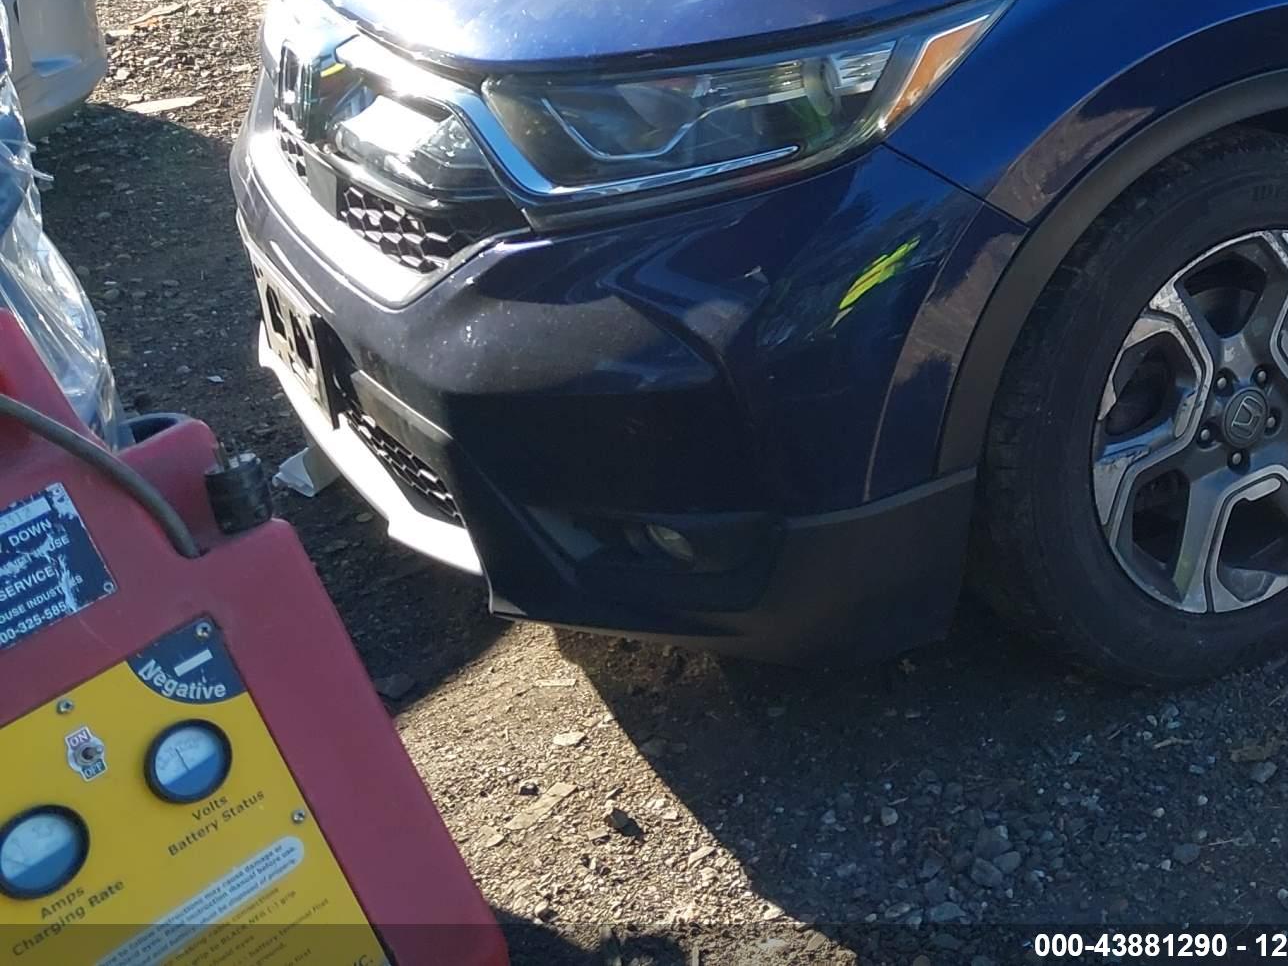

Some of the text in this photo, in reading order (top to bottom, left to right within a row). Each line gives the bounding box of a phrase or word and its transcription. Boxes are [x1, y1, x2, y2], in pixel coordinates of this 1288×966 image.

[8, 519, 52, 547] DOWN
[138, 659, 226, 700] Negative
[70, 731, 88, 747] ON
[84, 761, 102, 778] OFF
[168, 790, 265, 856] Battery Status
[192, 796, 228, 821] Volts
[40, 886, 85, 919] Amps
[12, 880, 125, 956] Charging Rate
